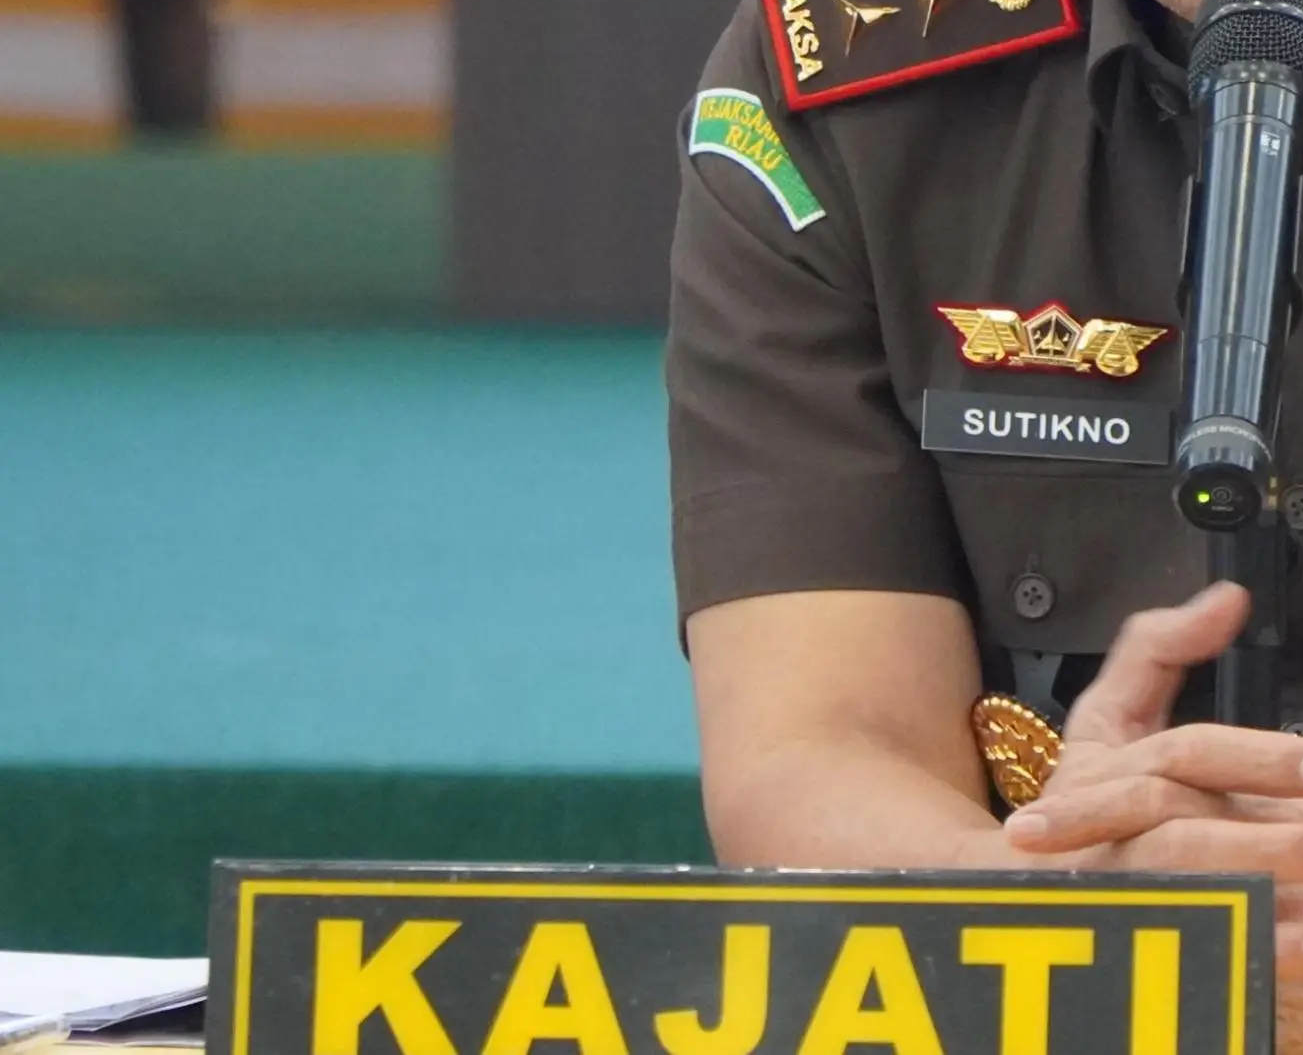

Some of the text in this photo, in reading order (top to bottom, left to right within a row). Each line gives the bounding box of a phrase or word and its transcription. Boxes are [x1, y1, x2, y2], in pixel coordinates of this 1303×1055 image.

[723, 124, 784, 171] RIAU
[963, 408, 1131, 445] SUTIKNO
[313, 918, 1181, 1055] KAJATI
